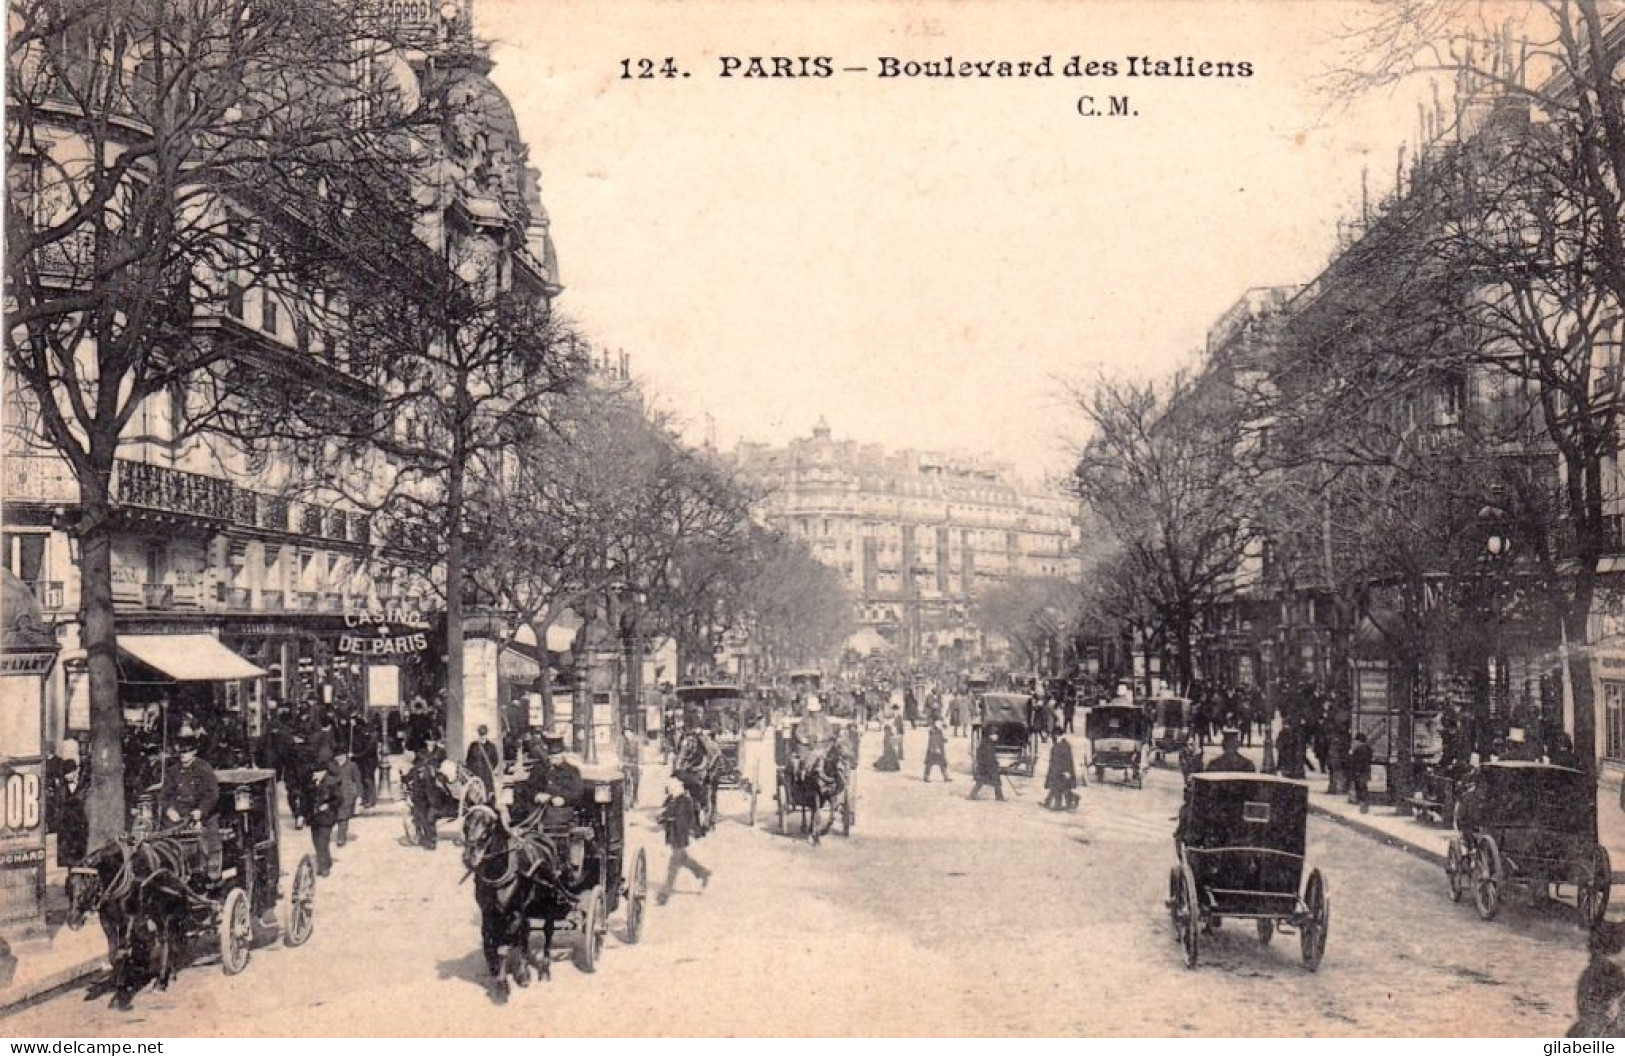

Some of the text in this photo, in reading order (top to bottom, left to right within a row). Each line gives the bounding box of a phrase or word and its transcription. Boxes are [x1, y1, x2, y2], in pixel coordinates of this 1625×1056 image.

[344, 607, 421, 628] CASINO
[338, 633, 428, 654] DE PARIS
